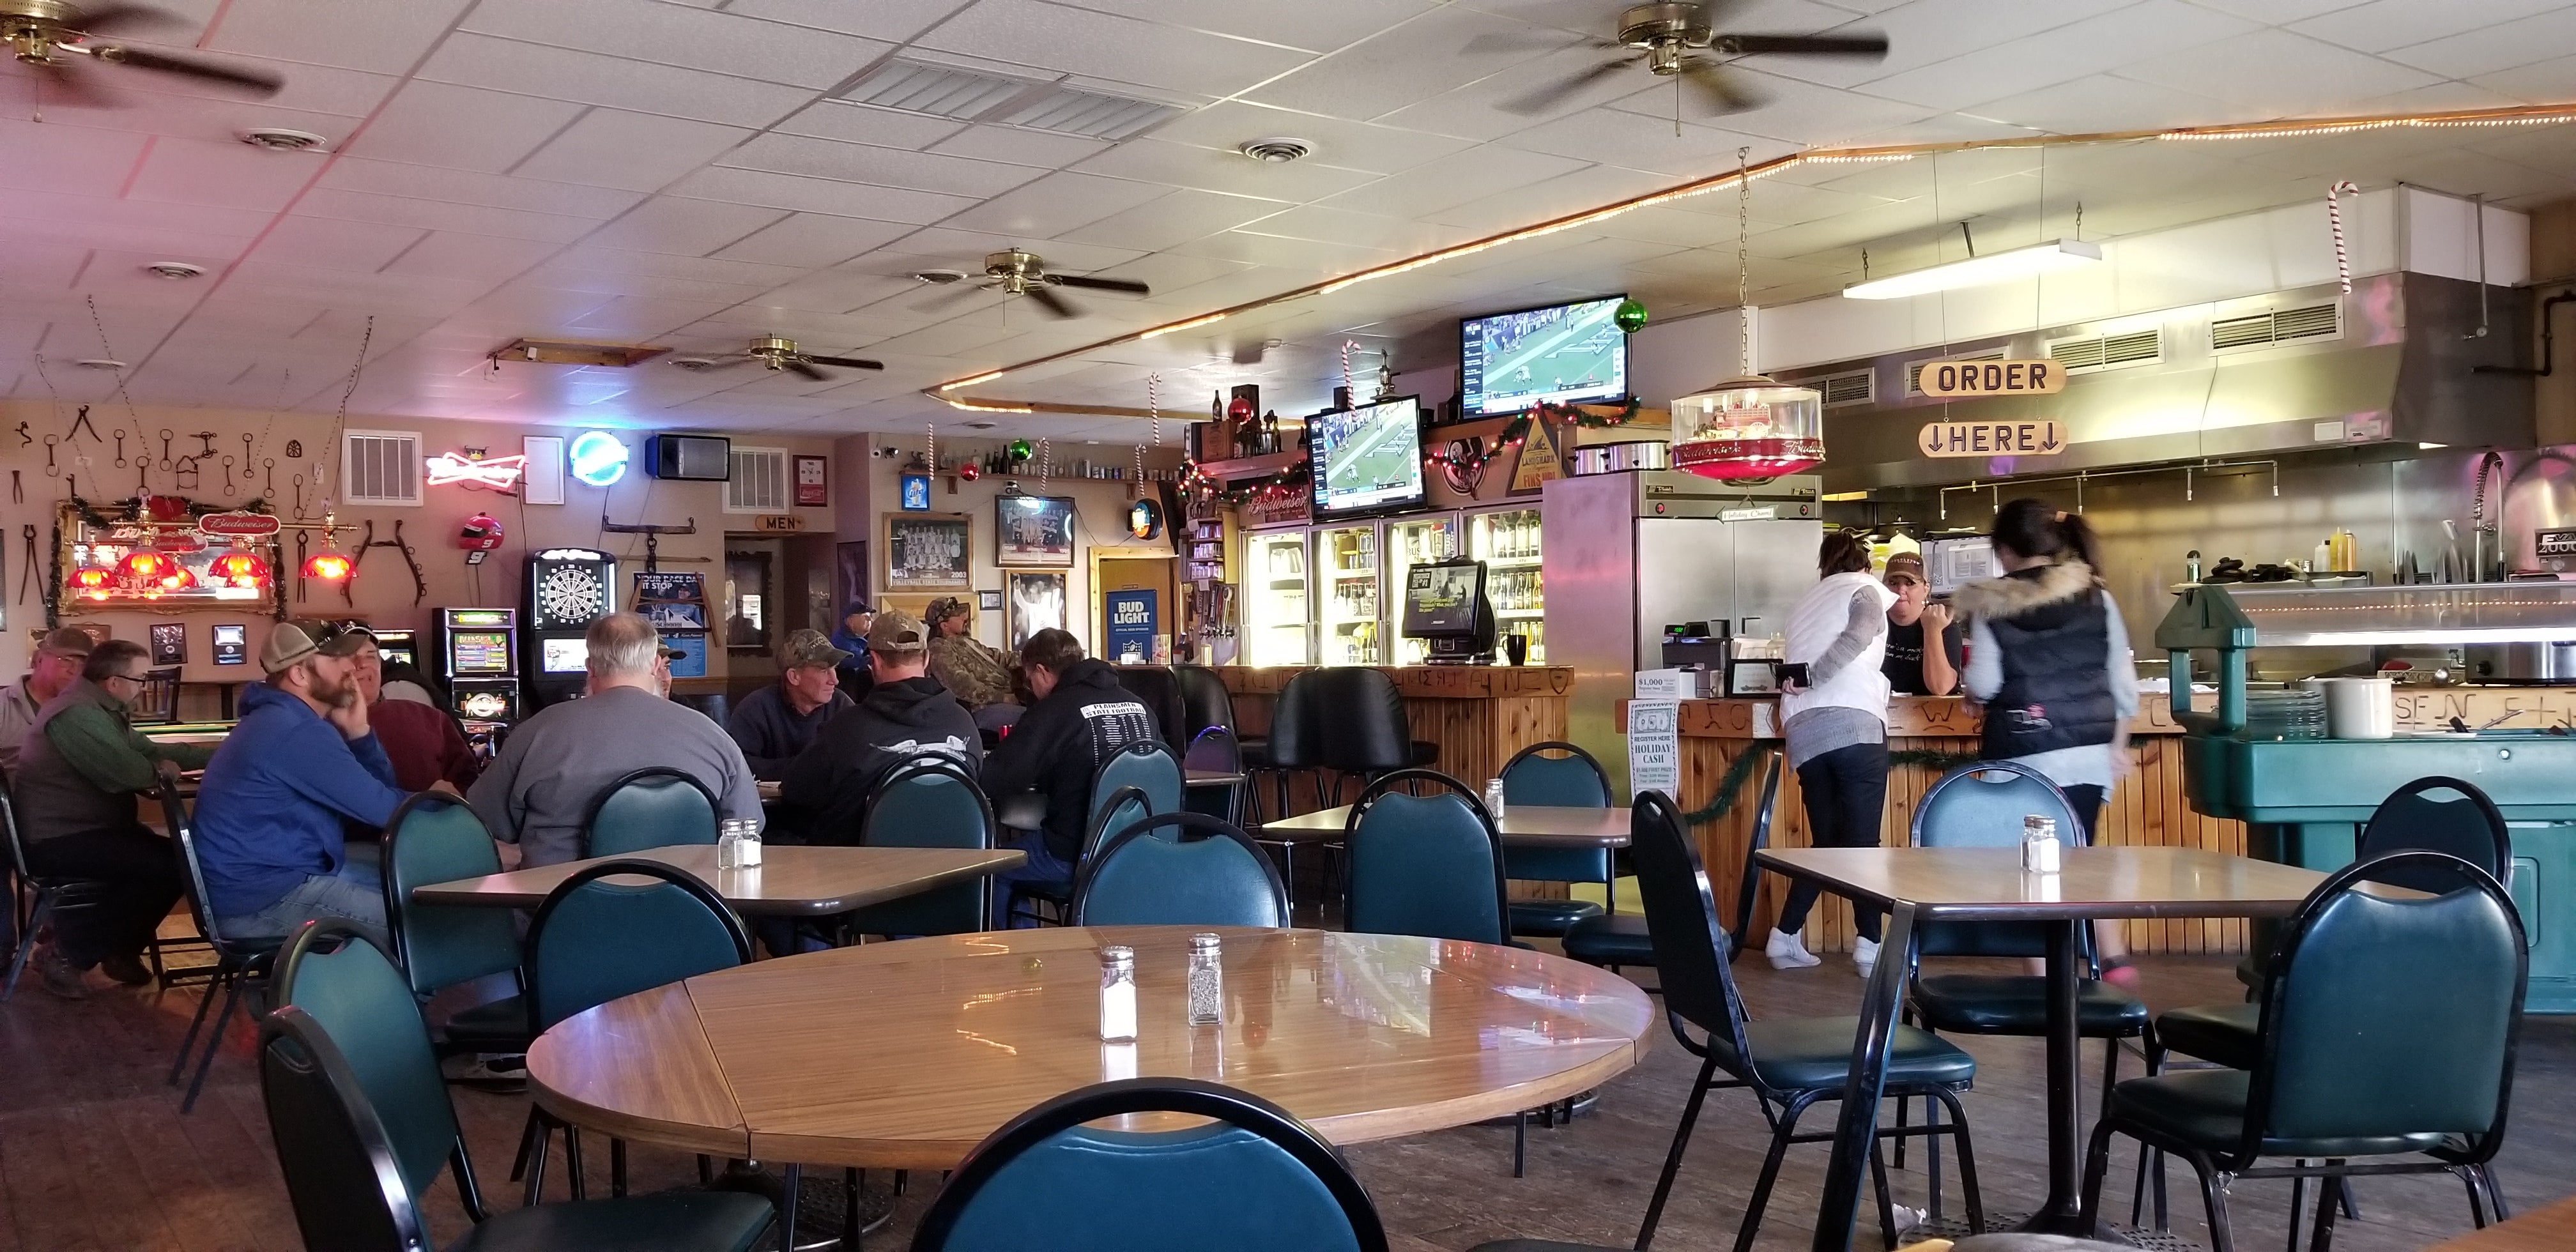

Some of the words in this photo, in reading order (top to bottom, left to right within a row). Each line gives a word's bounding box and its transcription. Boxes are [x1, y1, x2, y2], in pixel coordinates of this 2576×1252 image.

[1938, 364, 2047, 391] ORDER
[1949, 425, 2035, 452] HERE
[1524, 473, 1541, 487] FINS
[1247, 492, 1308, 516] Budweiser
[208, 517, 273, 529] Budweiser
[767, 517, 795, 529] MEN
[1119, 601, 1144, 613] BUD
[1114, 612, 1149, 624] LIGHT
[1639, 678, 1662, 687] $1,000
[1635, 744, 1671, 754] HOLIDAY
[1643, 754, 1664, 763] CASH
